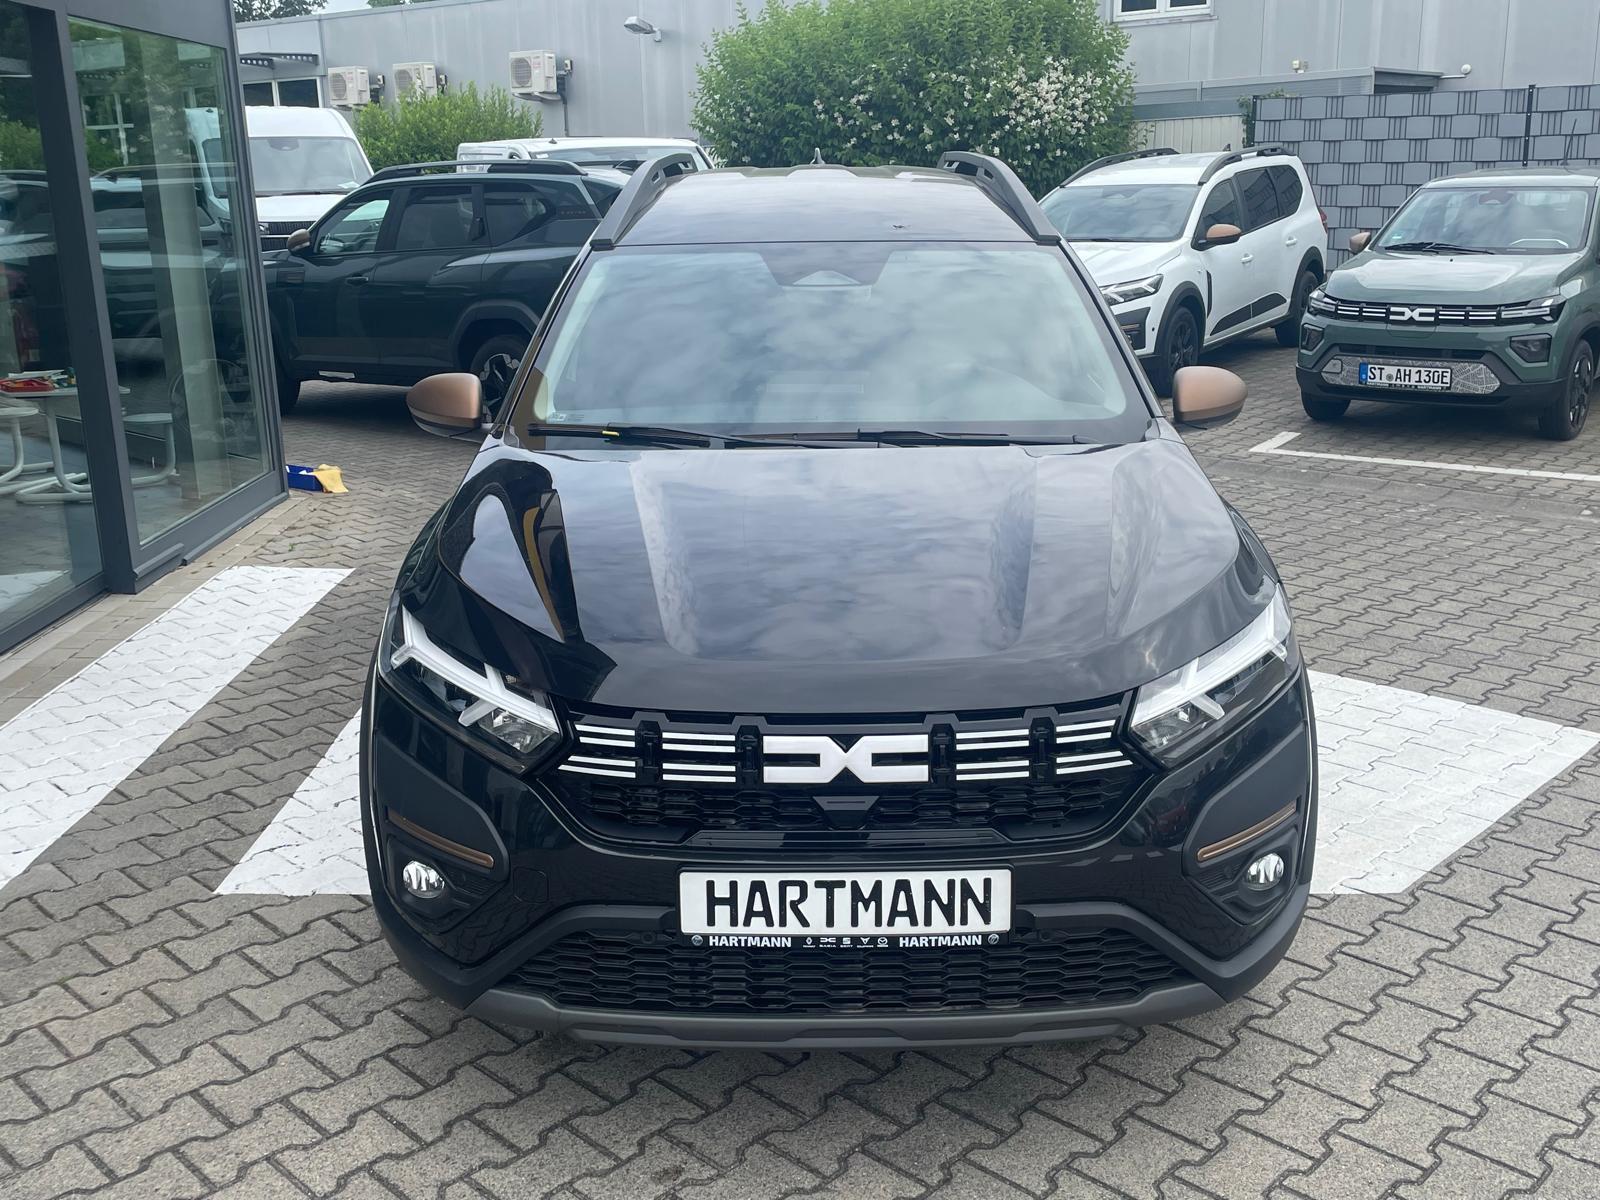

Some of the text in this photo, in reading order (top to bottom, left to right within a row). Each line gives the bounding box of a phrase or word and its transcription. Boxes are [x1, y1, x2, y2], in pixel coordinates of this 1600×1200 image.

[1368, 366, 1450, 385] ST AH 130E
[706, 877, 992, 928] HARTMANN
[709, 935, 792, 948] HARTMANN
[899, 934, 982, 948] HARTMANN
